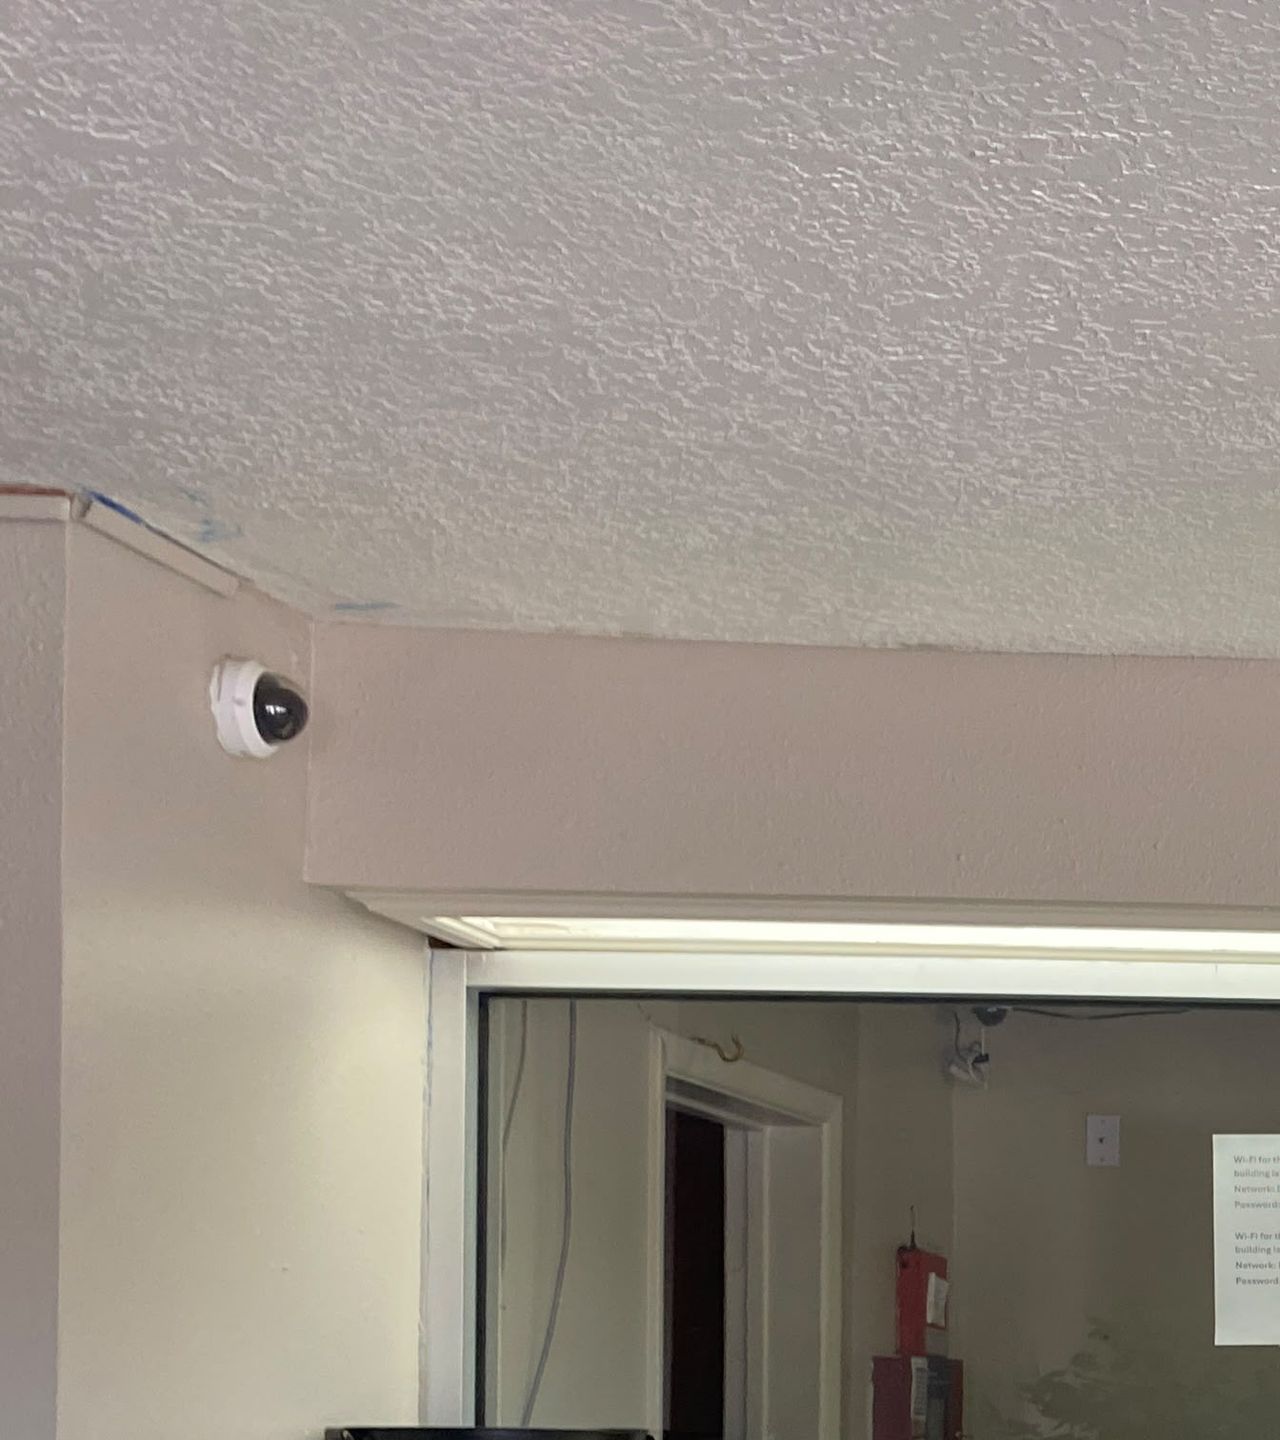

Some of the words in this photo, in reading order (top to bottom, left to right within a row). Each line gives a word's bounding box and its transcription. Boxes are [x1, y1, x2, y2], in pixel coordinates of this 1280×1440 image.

[1258, 1155, 1272, 1164] for
[1233, 1169, 1270, 1178] building
[1260, 1232, 1273, 1240] for
[1234, 1246, 1272, 1255] building
